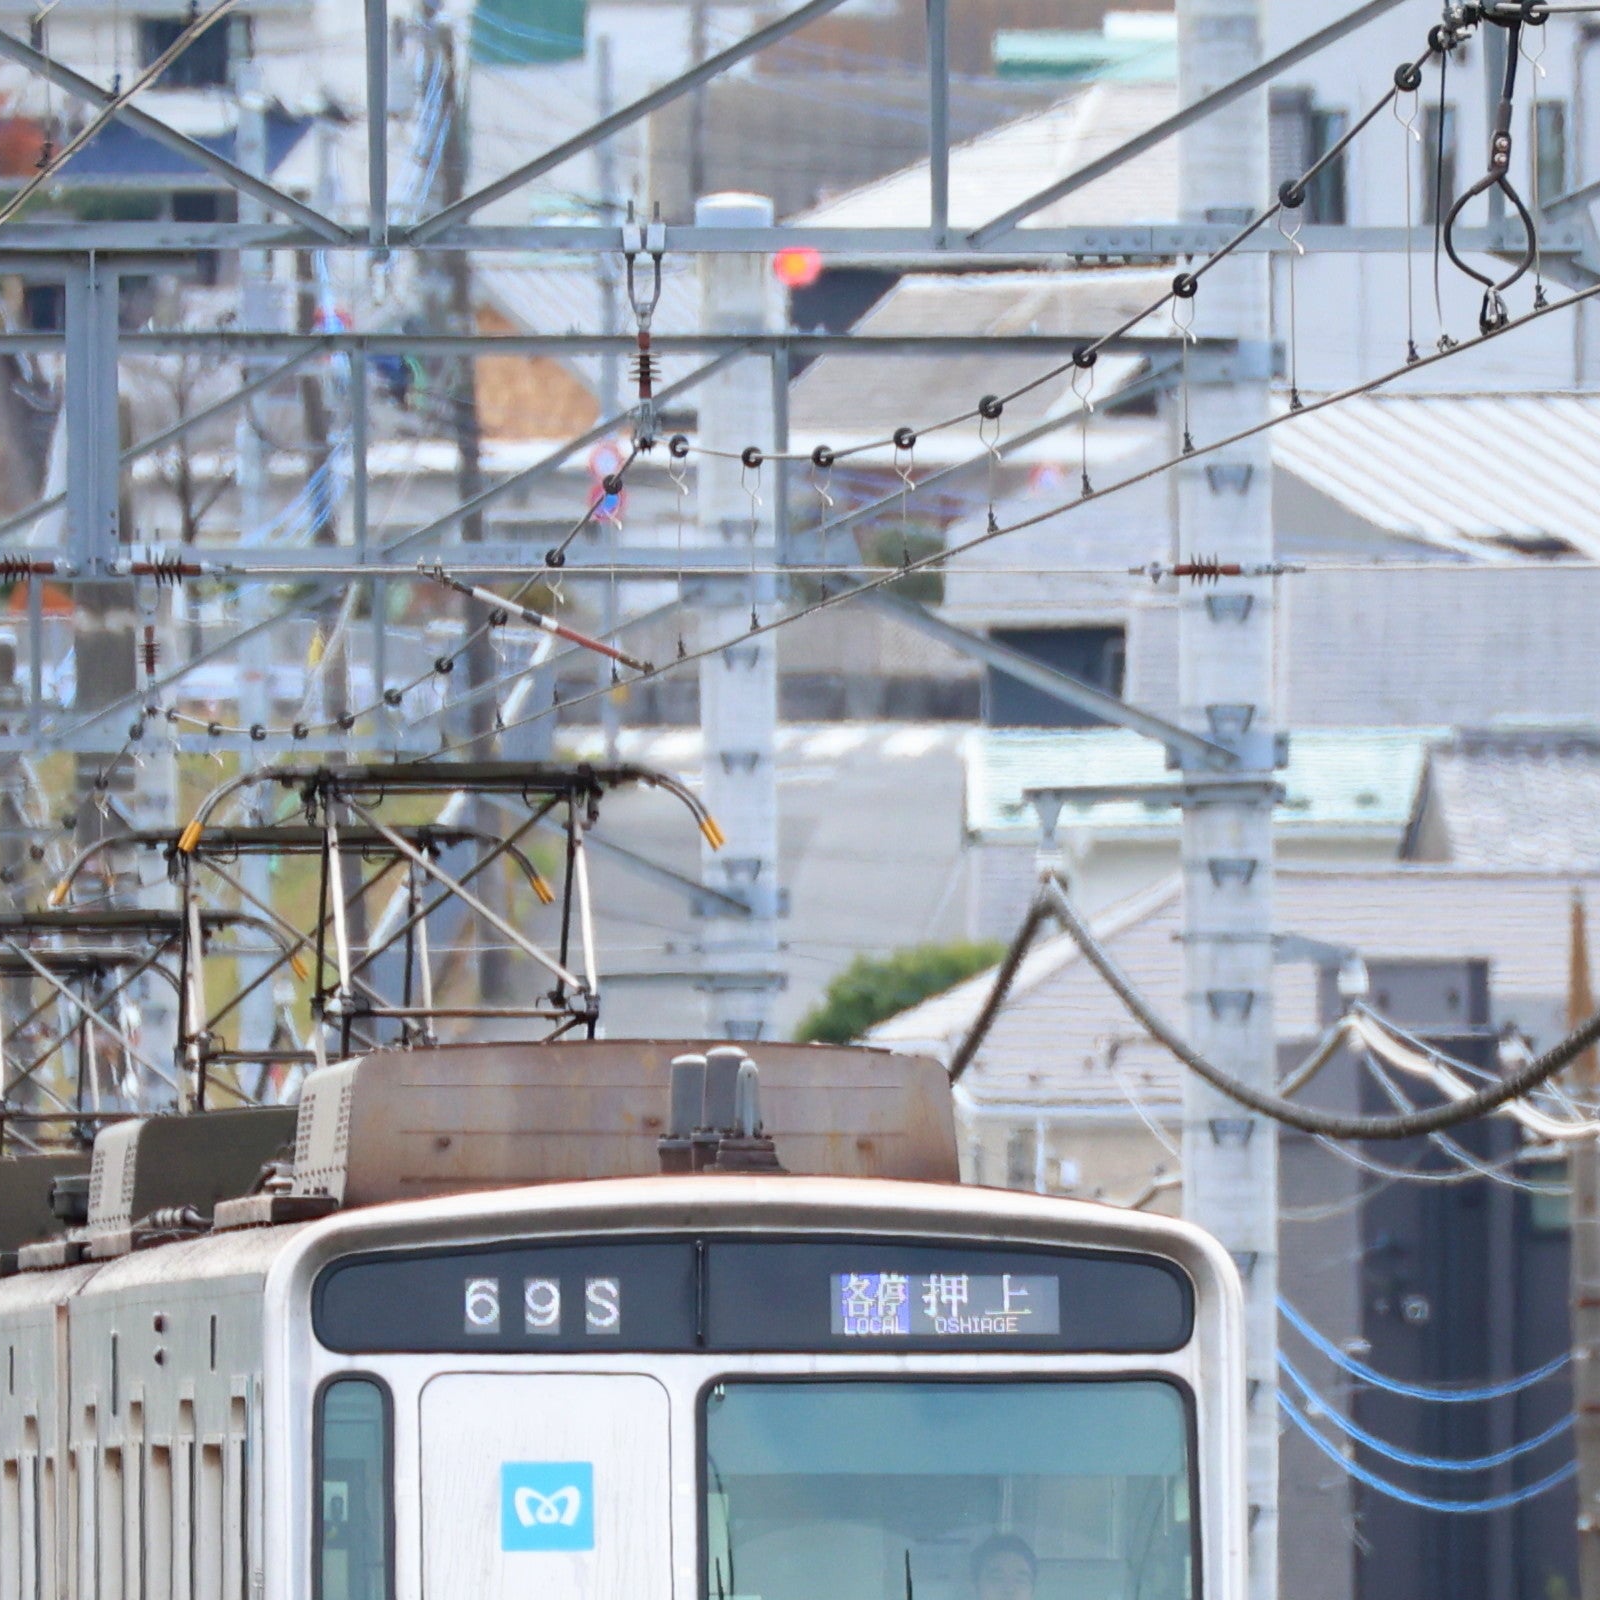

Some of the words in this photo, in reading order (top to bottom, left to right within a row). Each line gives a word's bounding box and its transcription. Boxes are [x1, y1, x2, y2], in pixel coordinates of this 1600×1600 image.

[842, 1272, 909, 1317] 各停
[922, 1273, 1033, 1317] 押上
[844, 1317, 907, 1334] LOCAL
[935, 1317, 1019, 1334] OSHIAGE
